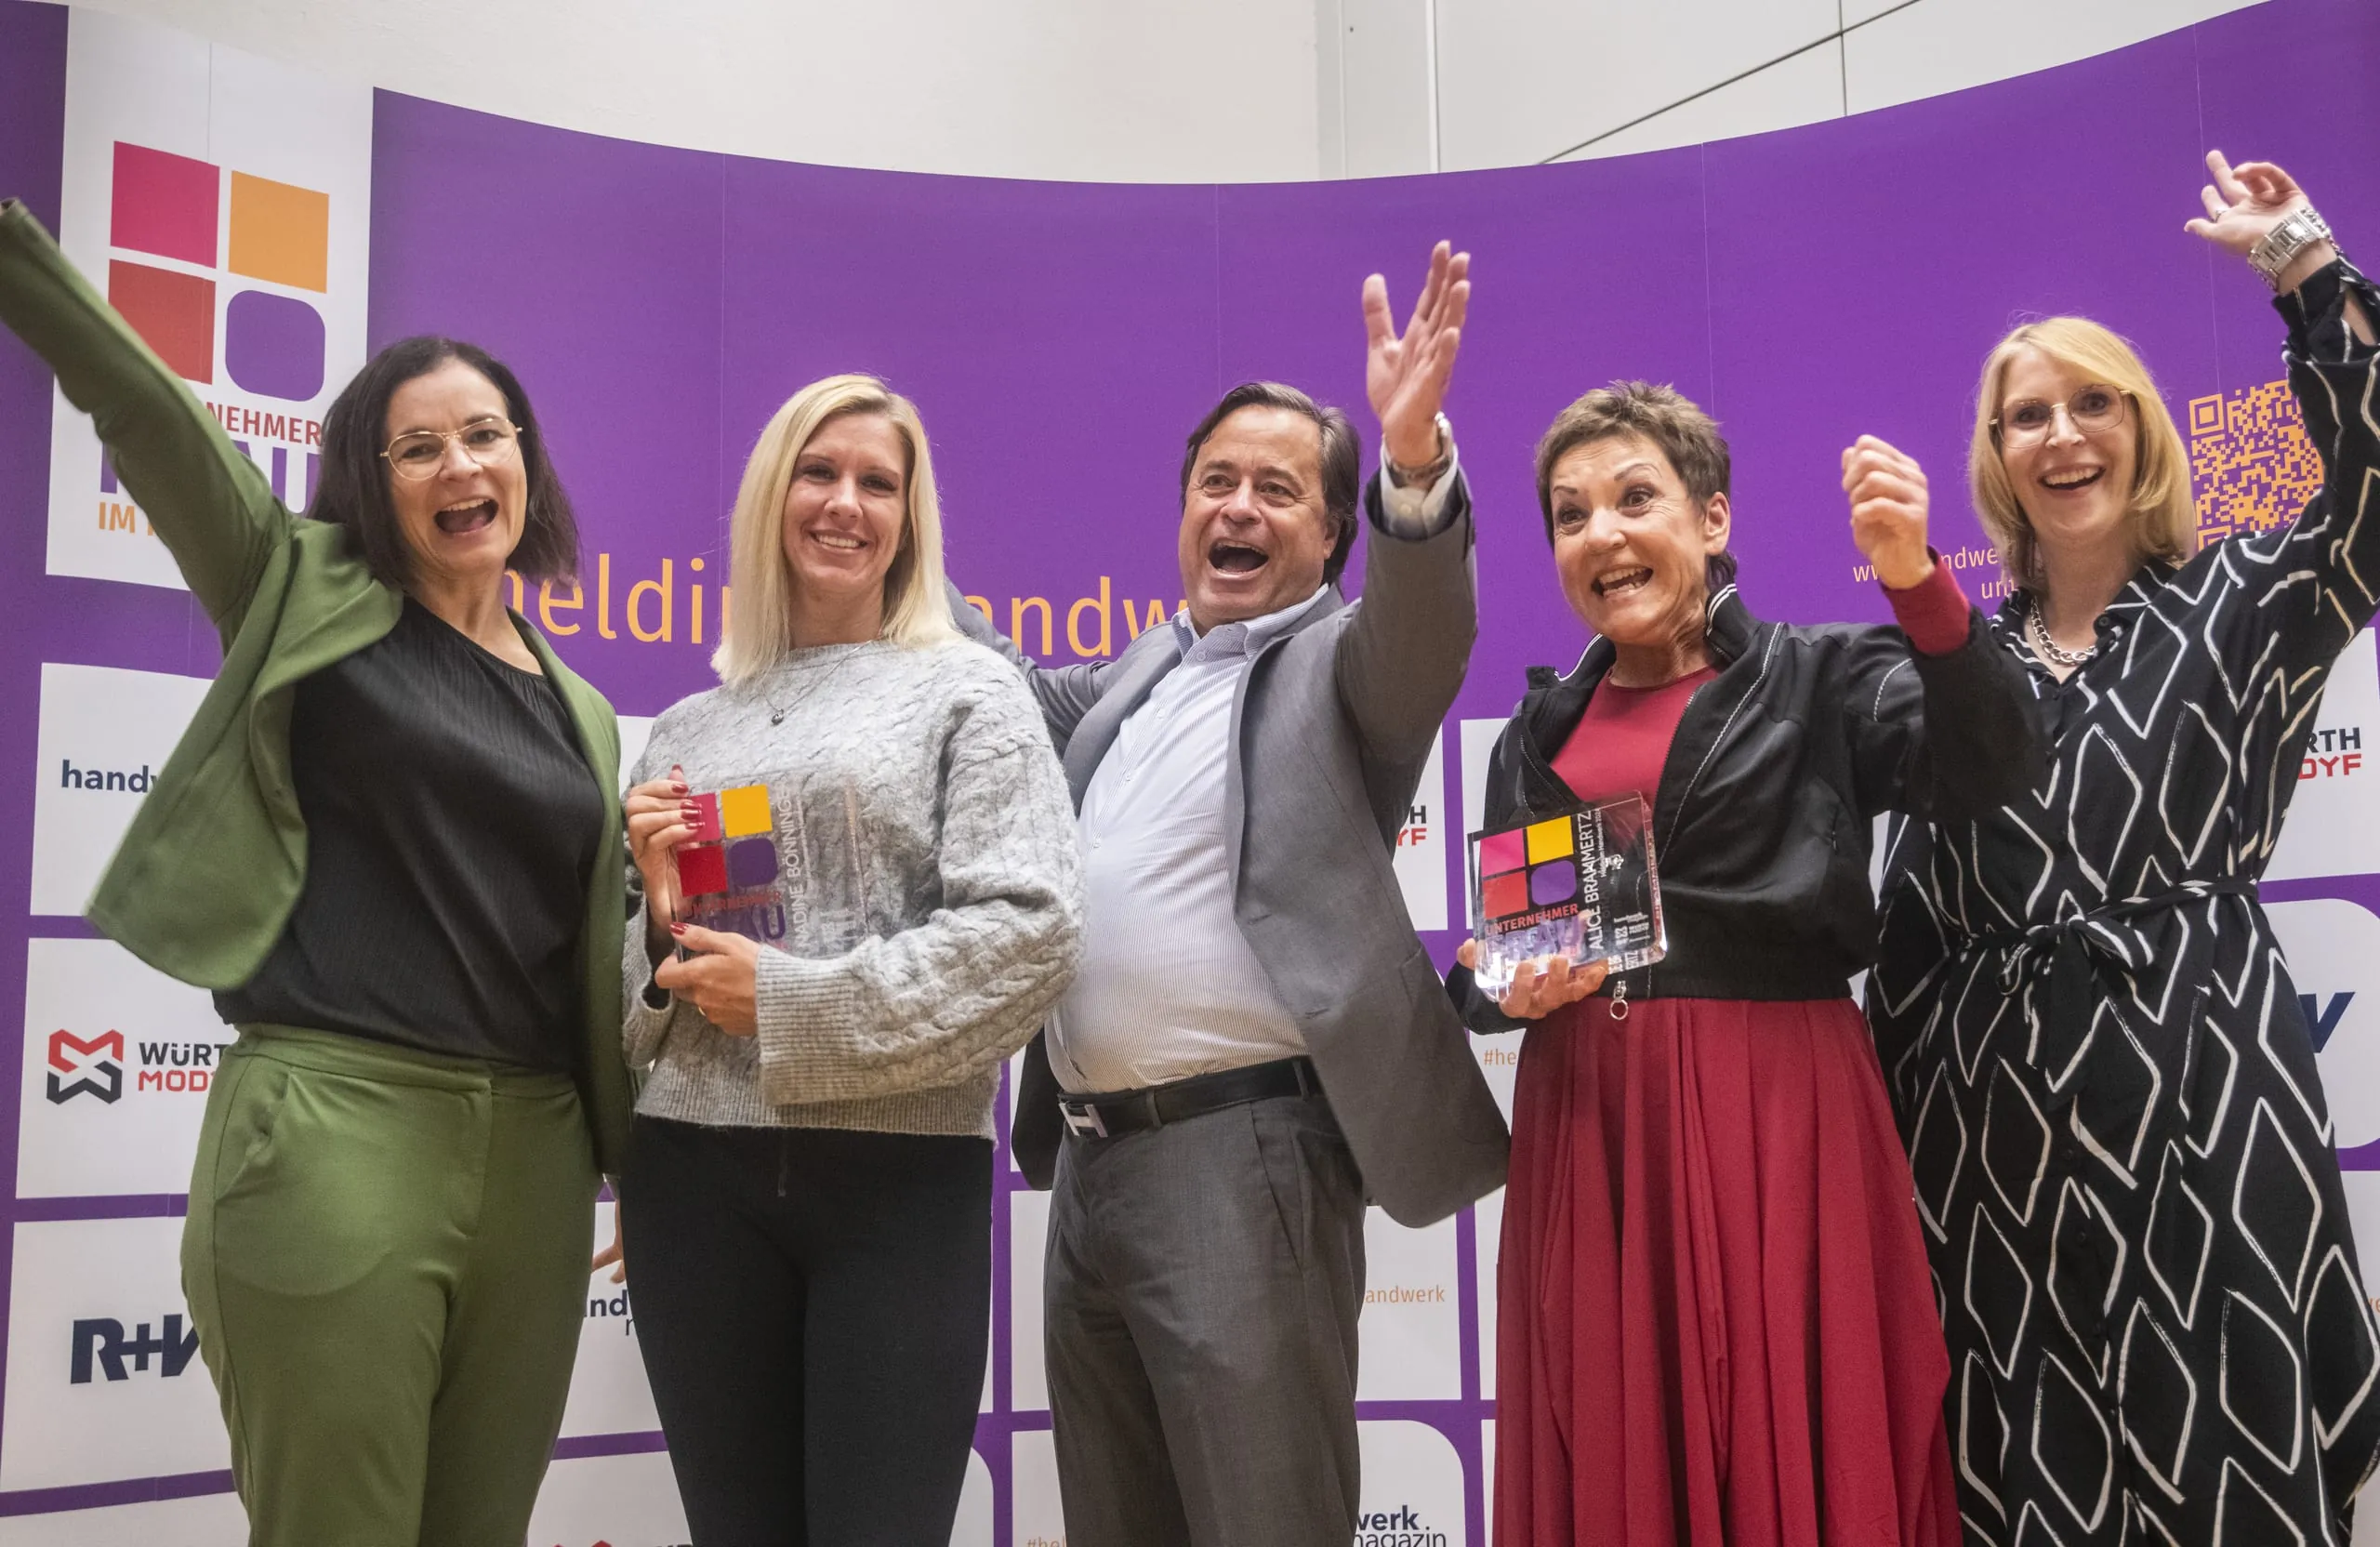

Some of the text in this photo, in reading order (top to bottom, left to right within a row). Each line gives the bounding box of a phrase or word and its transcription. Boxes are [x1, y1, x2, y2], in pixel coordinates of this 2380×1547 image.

[98, 501, 136, 534] IM
[60, 759, 157, 793] hand
[1577, 809, 1605, 951] ALICE BRAMMERTZ
[788, 883, 810, 949] NADINE
[1485, 903, 1579, 936] UNTERNEHMER
[138, 1069, 216, 1092] MOD
[589, 1289, 628, 1317] nd
[1365, 1283, 1446, 1303] andwerk
